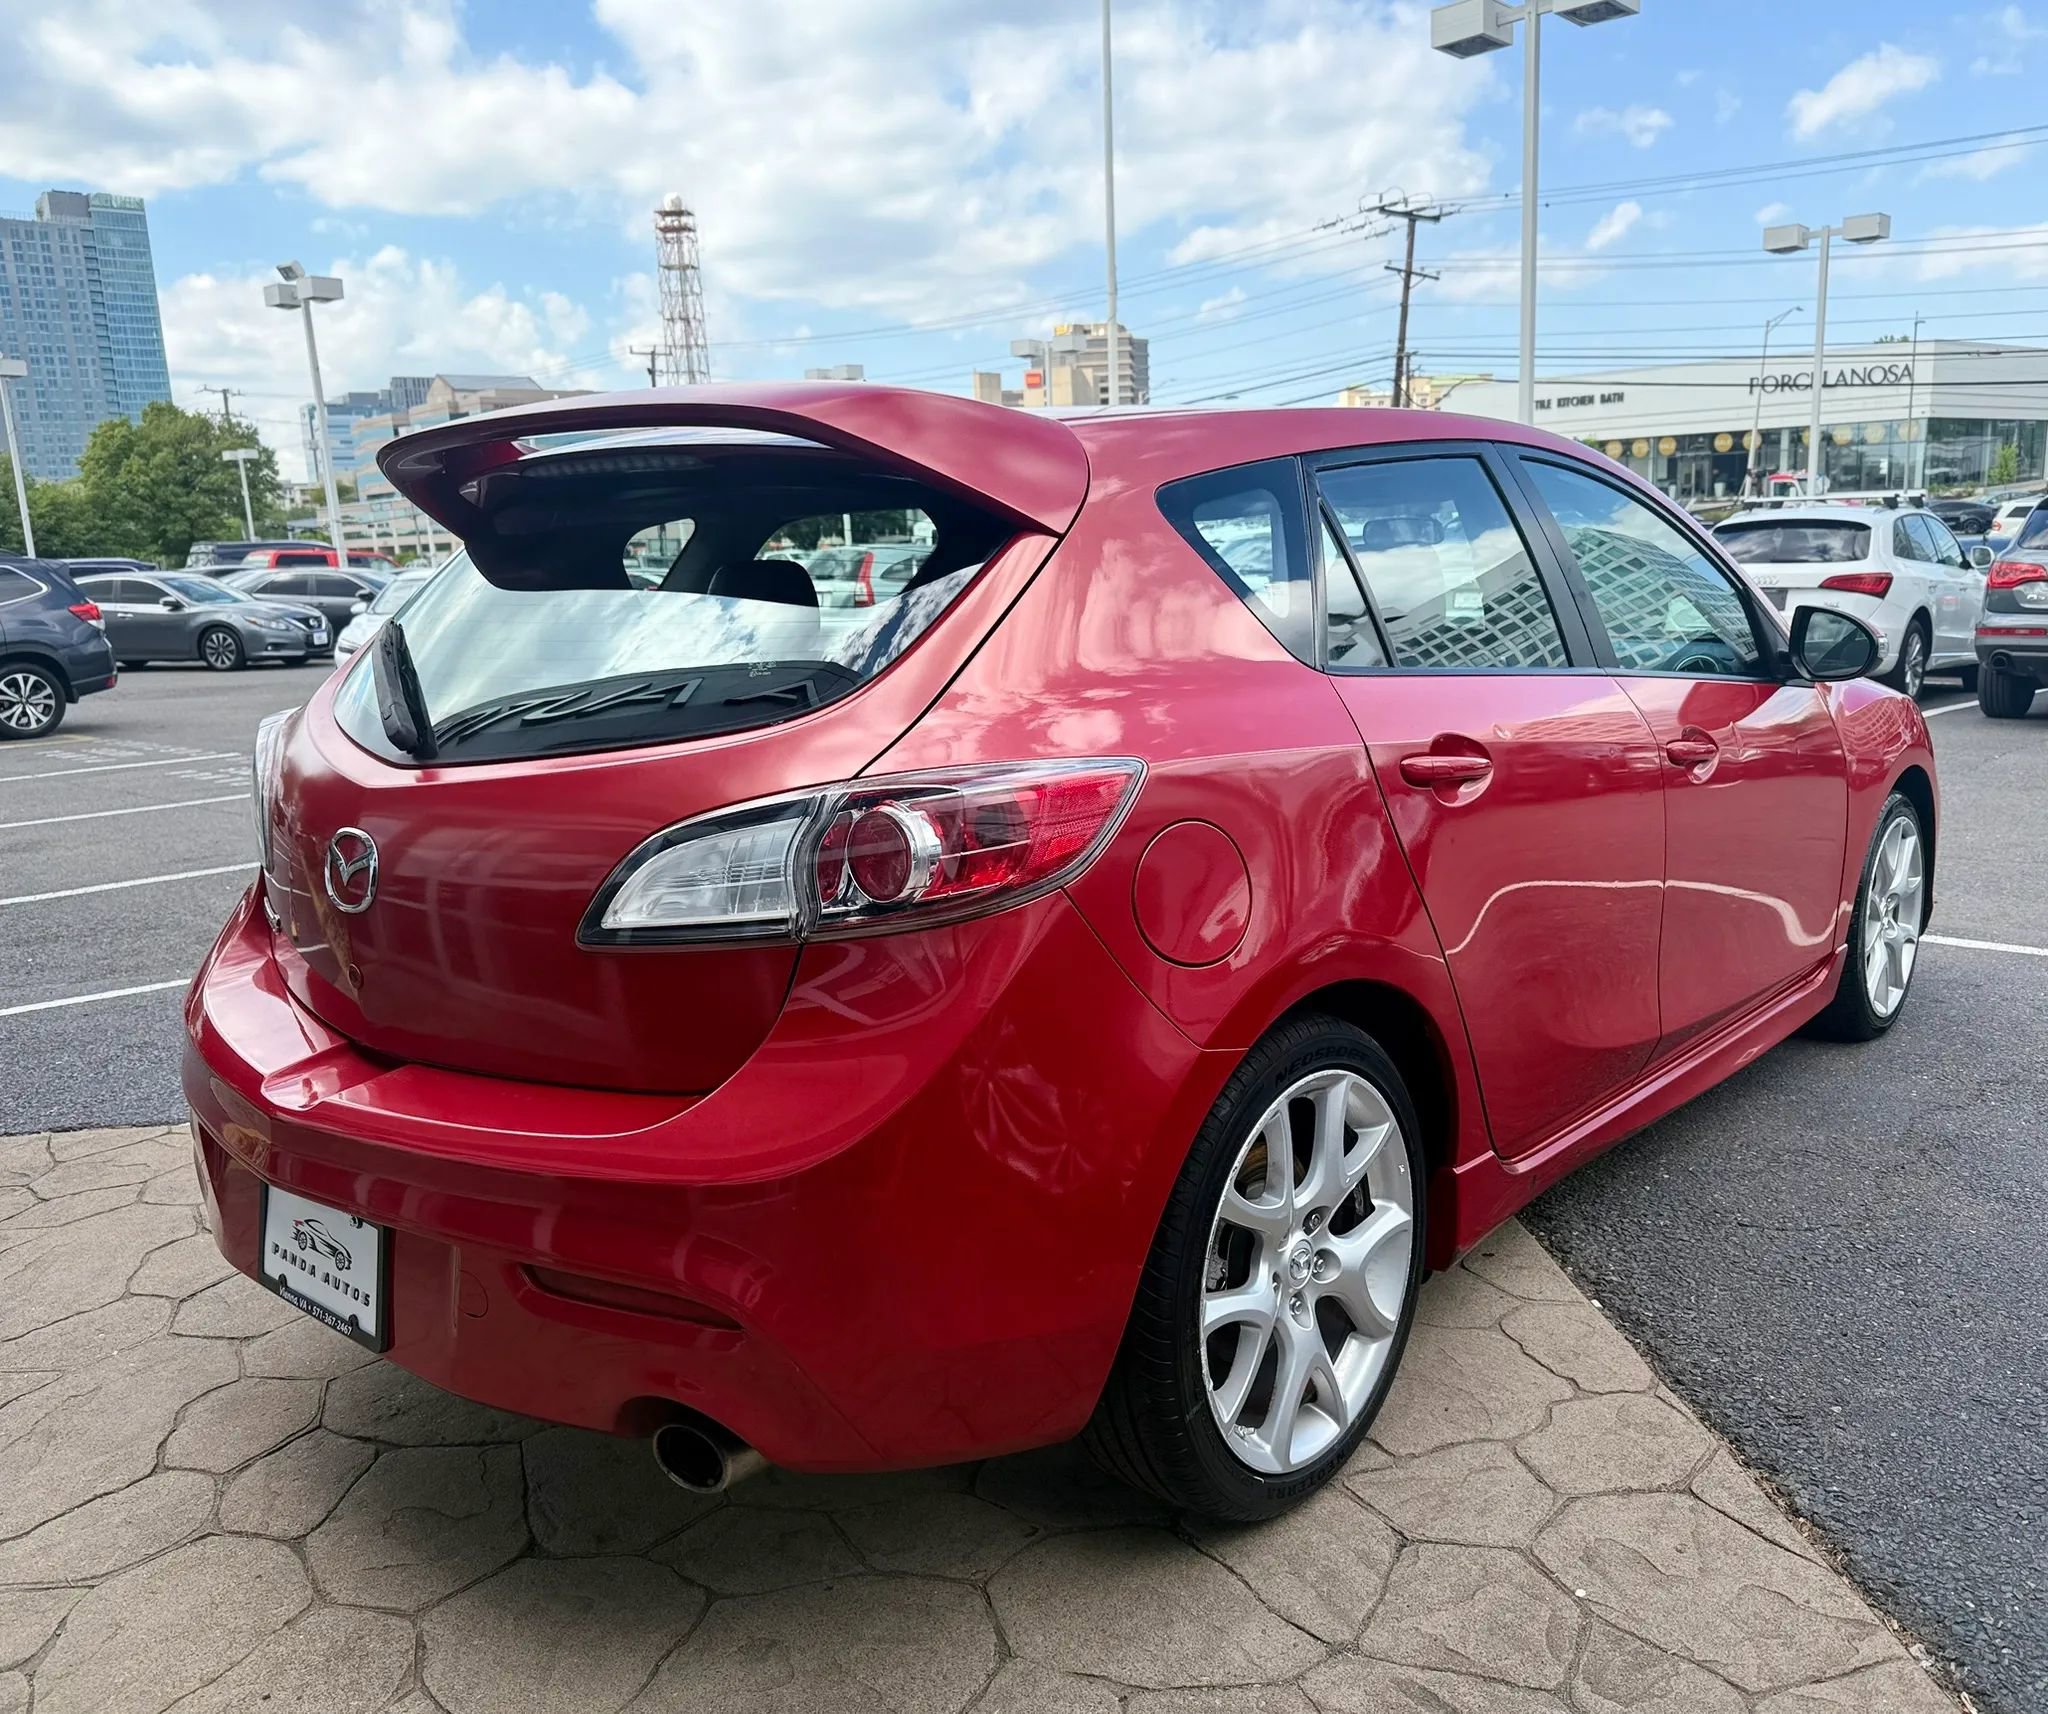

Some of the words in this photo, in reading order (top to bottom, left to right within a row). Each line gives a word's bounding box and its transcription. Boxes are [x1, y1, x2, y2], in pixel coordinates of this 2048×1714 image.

[1749, 364, 1912, 394] PORCLANOSA
[1535, 399, 1552, 411] TILE
[1600, 392, 1624, 405] BATH
[272, 1241, 316, 1277] PANDA
[321, 1272, 371, 1307] AUTOS
[299, 1298, 308, 1311] VA
